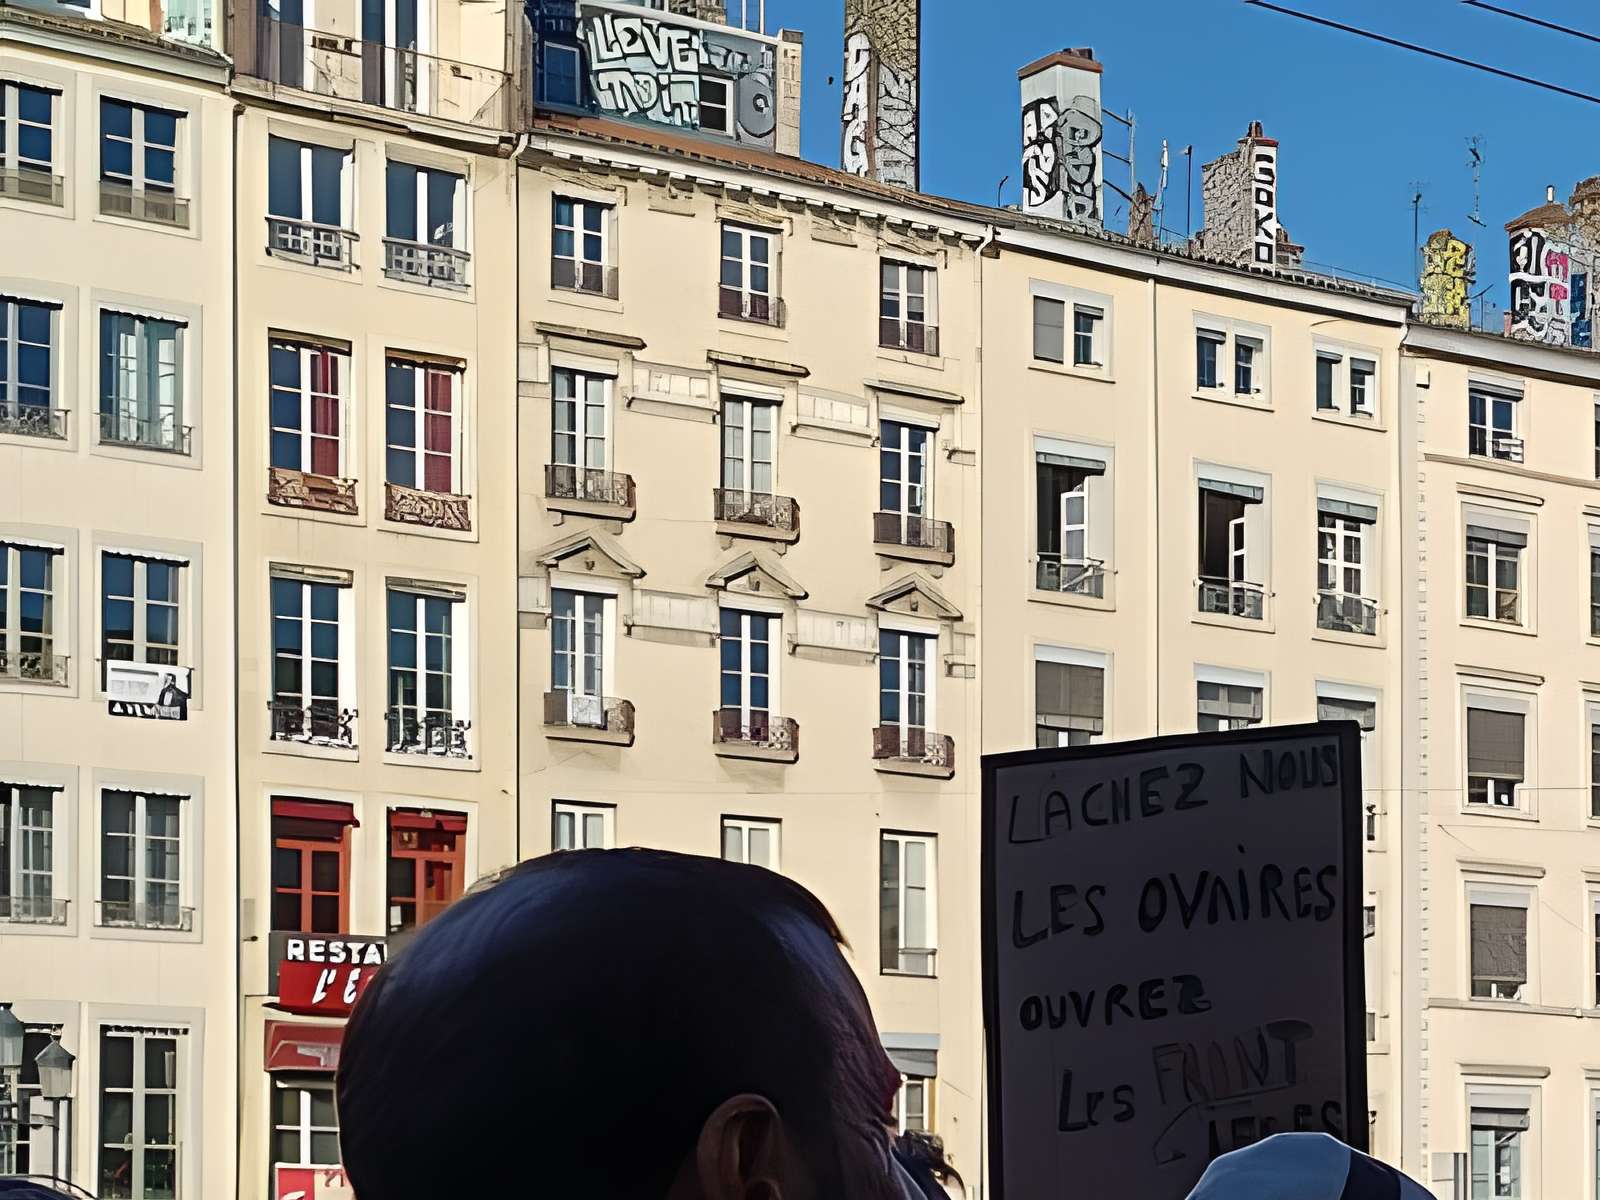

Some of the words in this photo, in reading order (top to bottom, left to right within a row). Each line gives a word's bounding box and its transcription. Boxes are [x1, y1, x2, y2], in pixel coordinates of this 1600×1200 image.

[1239, 744, 1339, 799] NOUS
[1012, 884, 1106, 949] LES
[287, 938, 387, 965] RESTA
[1019, 973, 1212, 1032] OUVREZ
